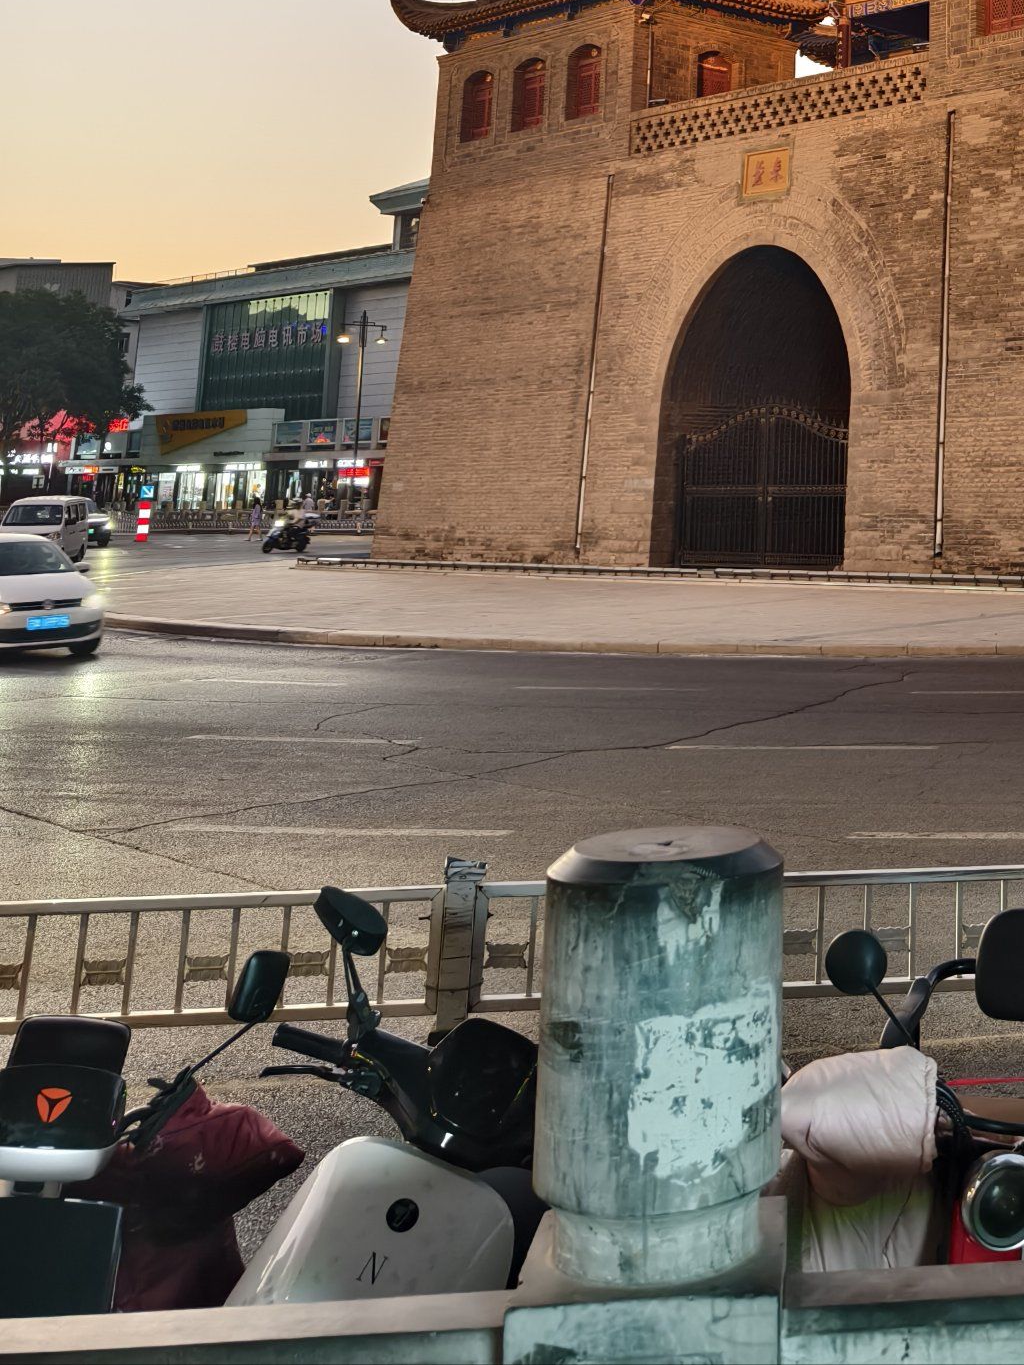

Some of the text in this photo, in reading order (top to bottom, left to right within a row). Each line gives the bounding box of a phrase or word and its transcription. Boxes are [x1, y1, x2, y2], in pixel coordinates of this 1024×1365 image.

[211, 321, 323, 353] 鼓楼电脑电讯市场
[356, 1251, 389, 1285] N
